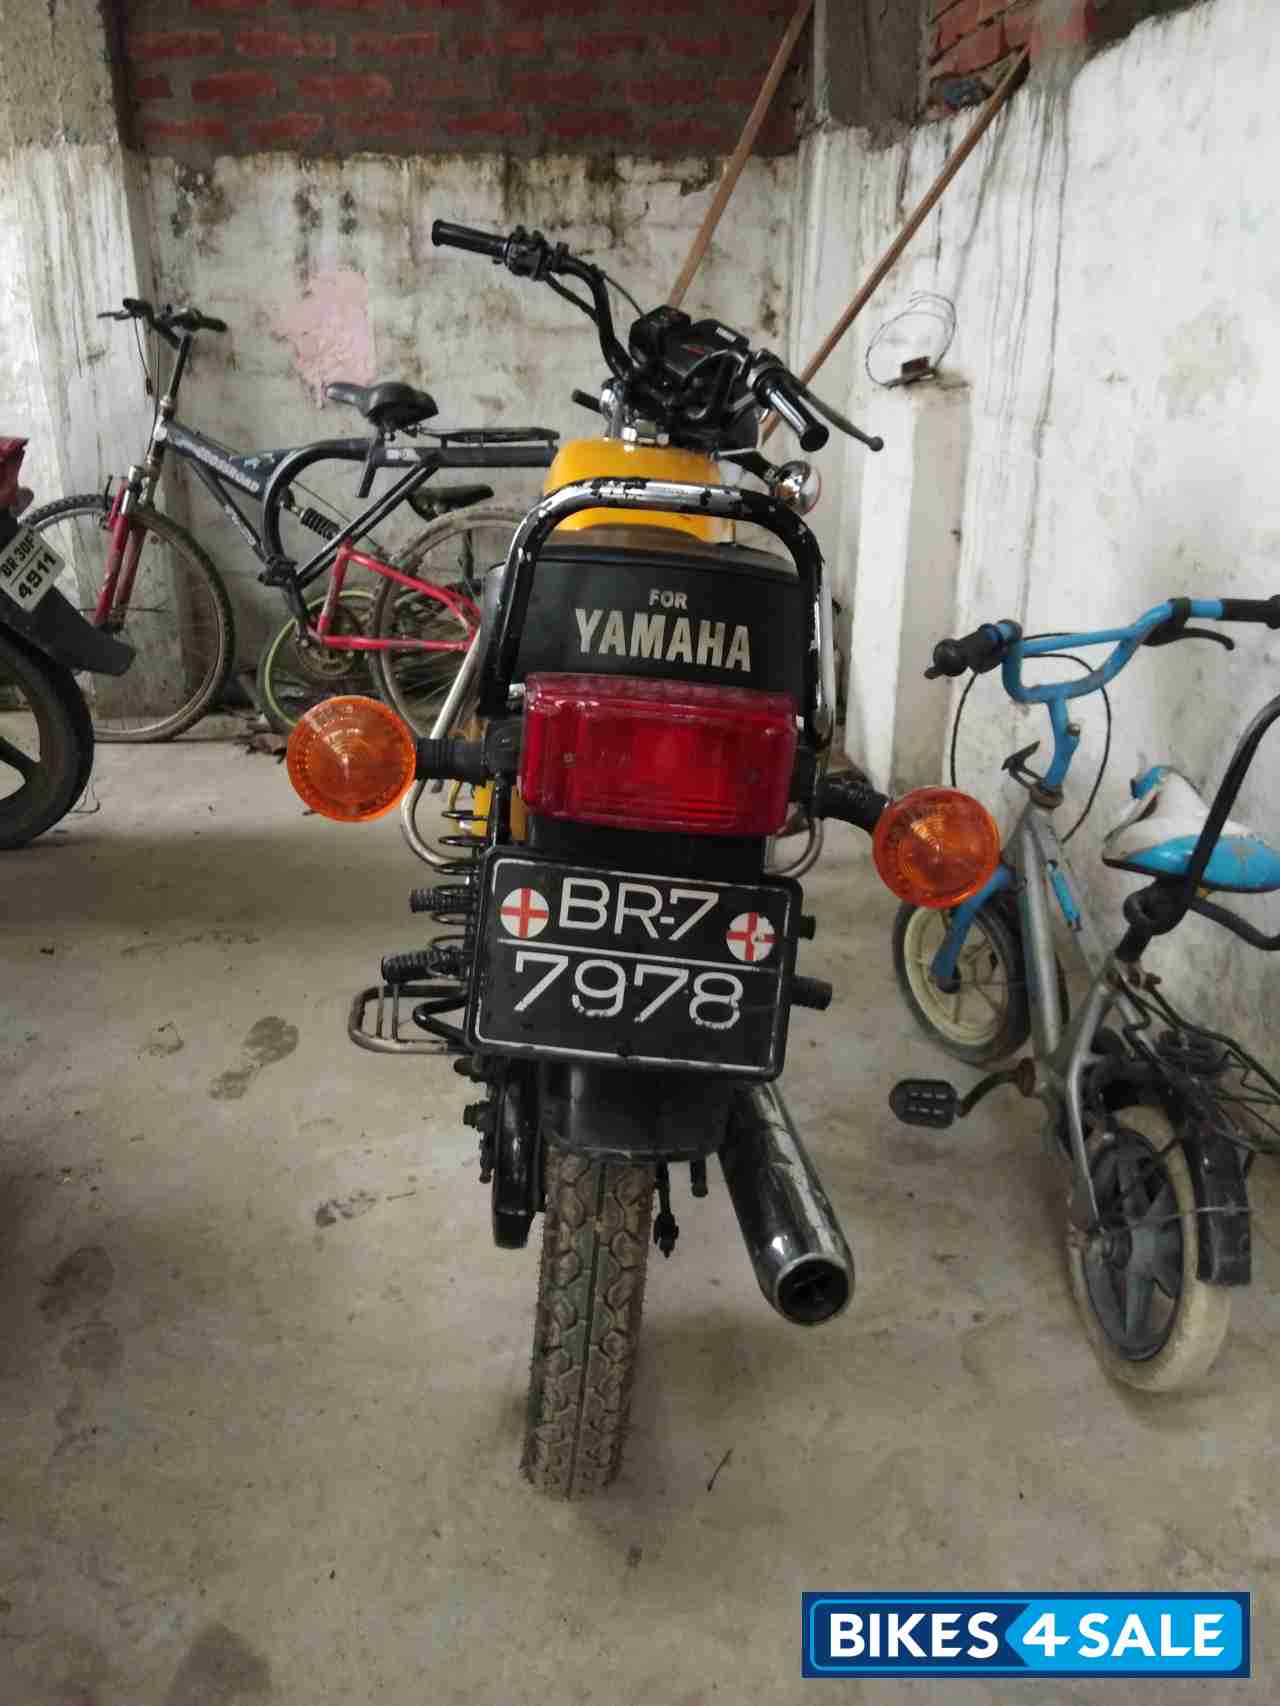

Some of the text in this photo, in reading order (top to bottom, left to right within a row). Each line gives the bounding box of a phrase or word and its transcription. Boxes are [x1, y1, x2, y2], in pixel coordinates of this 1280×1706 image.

[18, 552, 57, 599] 4911
[648, 588, 688, 610] FOR
[575, 608, 752, 672] YAMAHA
[558, 877, 719, 942] BR-7
[513, 950, 744, 1030] 7978
